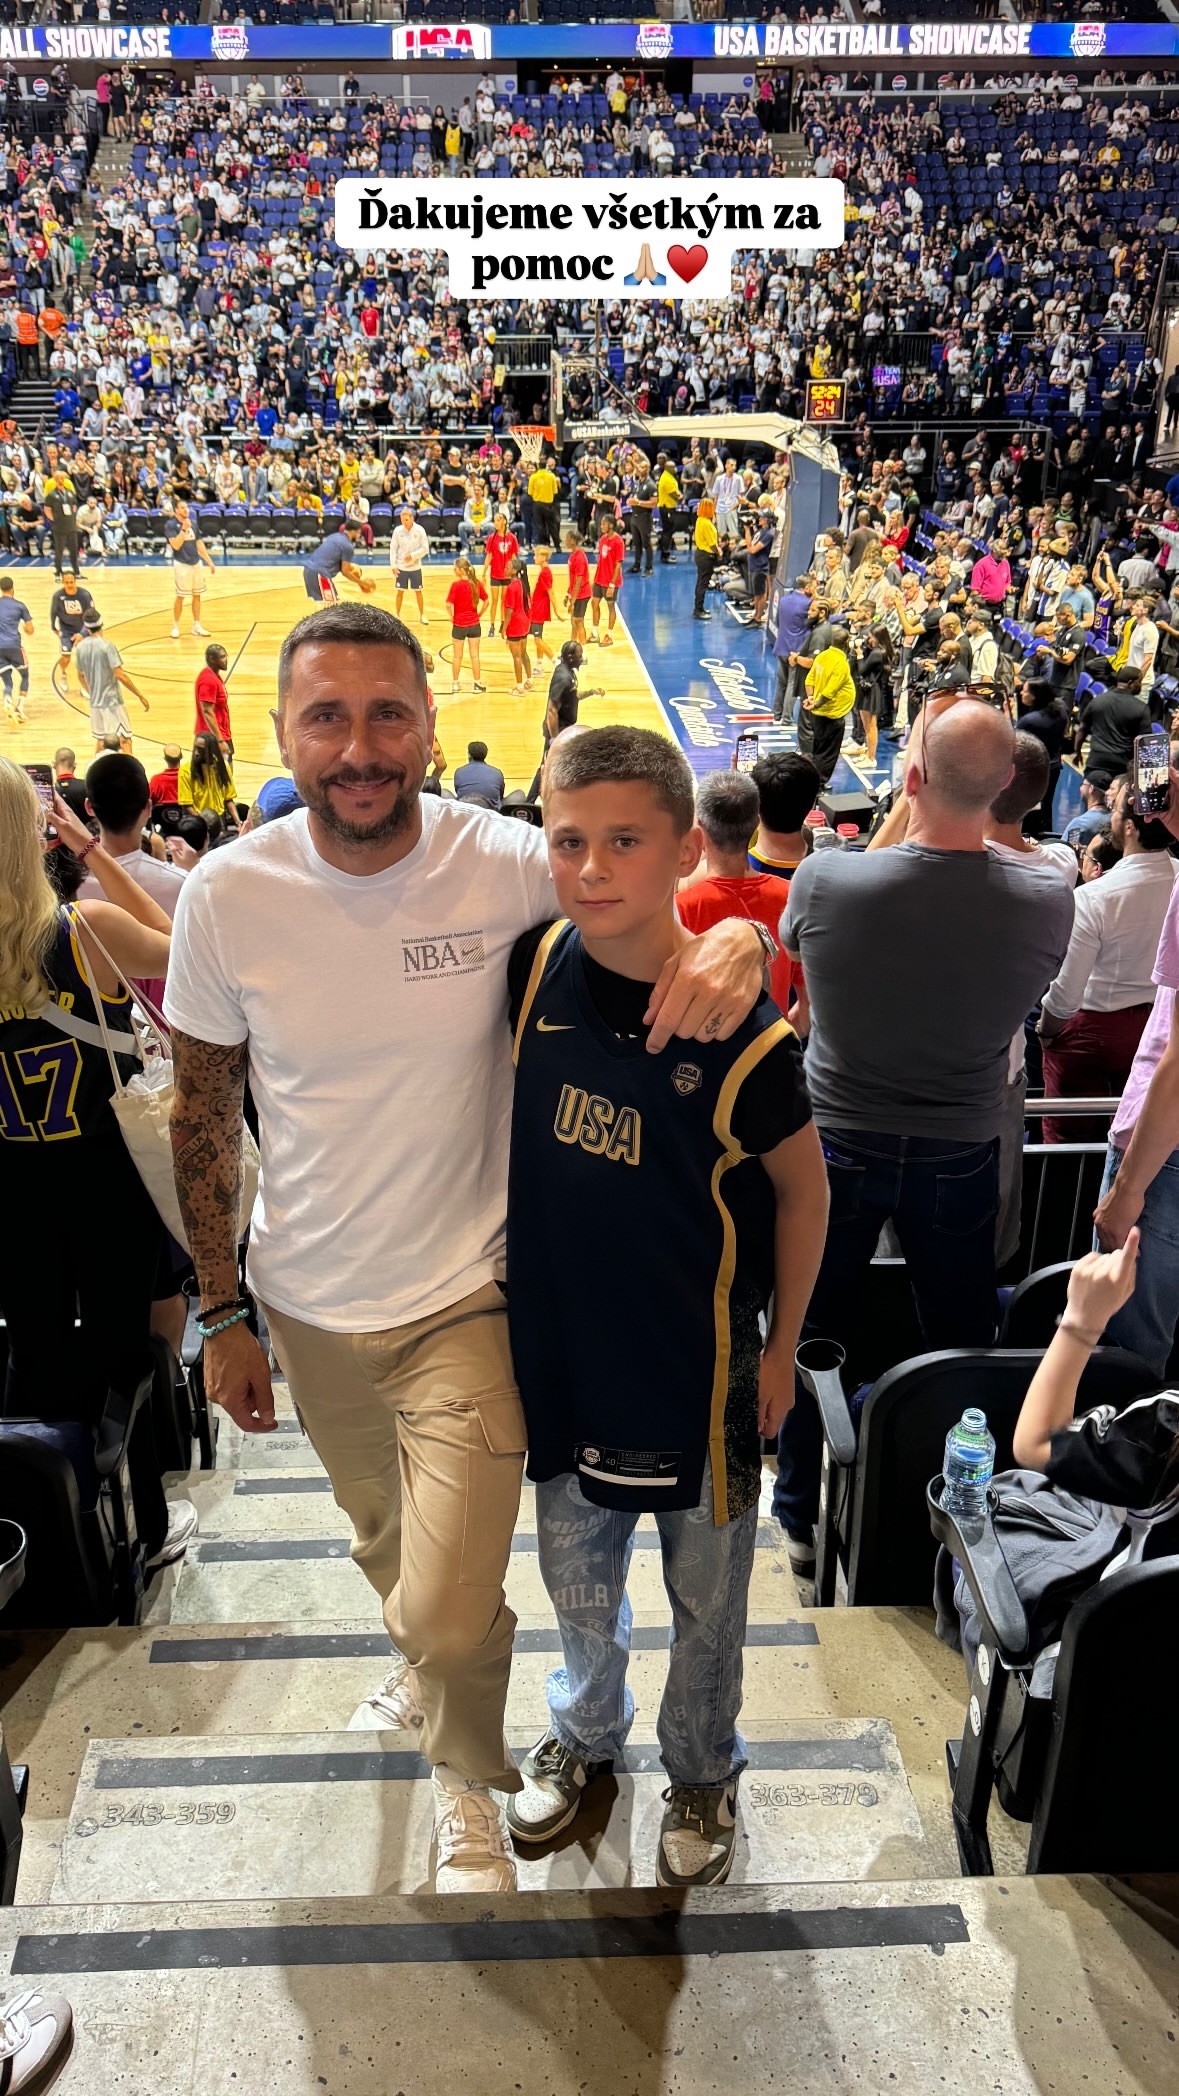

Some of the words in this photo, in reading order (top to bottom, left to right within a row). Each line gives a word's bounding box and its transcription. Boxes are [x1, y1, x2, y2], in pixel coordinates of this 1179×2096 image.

[45, 27, 172, 58] SHOWCASE
[713, 25, 760, 56] USA
[765, 25, 904, 56] BASKETBALL
[908, 25, 1032, 55] SHOWCASE
[877, 375, 898, 386] USA
[814, 400, 835, 417] 24
[402, 942, 461, 973] NBA
[679, 1065, 699, 1079] USA
[0, 1038, 83, 1142] 17
[553, 1083, 642, 1166] USA
[102, 1801, 236, 1828] 343-359
